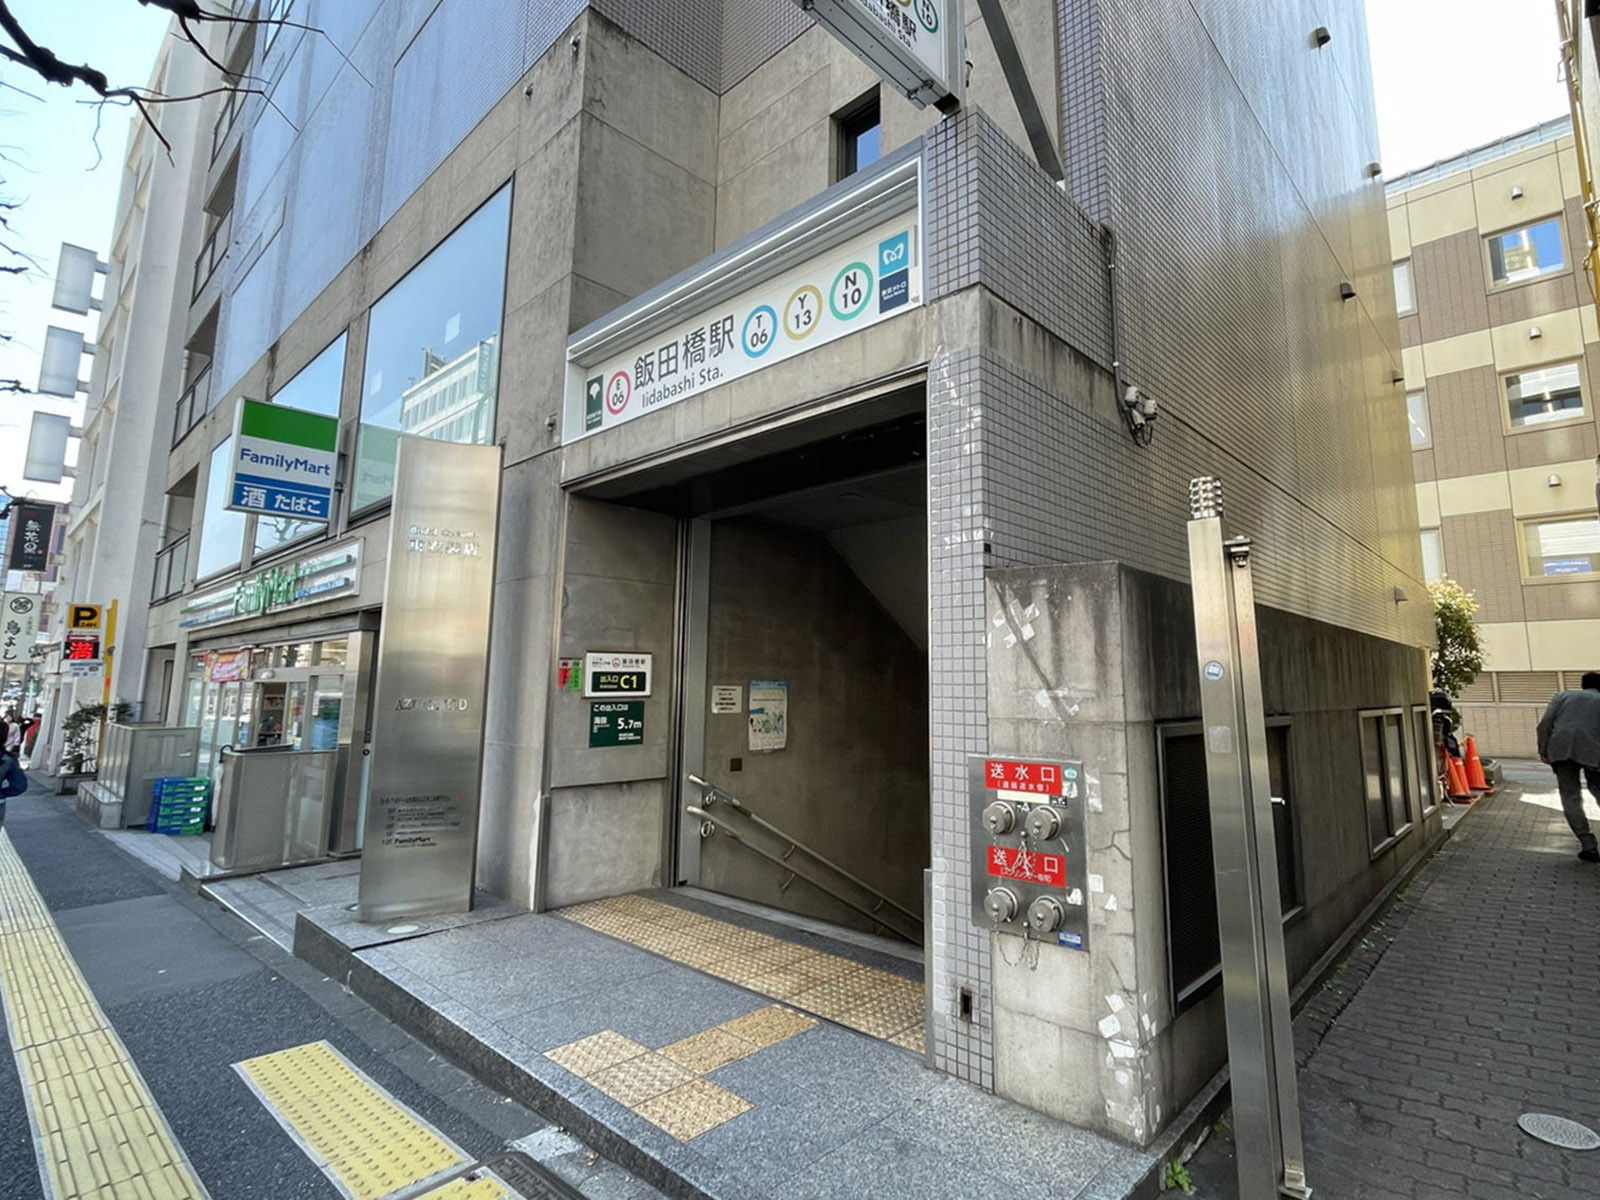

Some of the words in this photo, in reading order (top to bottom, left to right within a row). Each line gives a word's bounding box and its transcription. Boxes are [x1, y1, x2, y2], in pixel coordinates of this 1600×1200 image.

[921, 8, 933, 26] 10
[845, 271, 857, 290] N
[798, 294, 807, 309] Y
[842, 288, 862, 309] 10
[755, 314, 763, 328] T
[794, 310, 812, 329] 13
[750, 328, 769, 348] 06
[634, 313, 735, 392] 飯田橋駅
[616, 379, 621, 390] E
[642, 371, 695, 408] Iidabashi
[699, 366, 724, 386] Sta.
[612, 391, 625, 406] 06
[240, 447, 331, 476] FamilyMart
[241, 486, 267, 508] 酒
[274, 494, 321, 515] たばこ
[73, 607, 98, 627] P
[620, 675, 638, 689] C1
[617, 716, 642, 730] 5.7m
[991, 762, 1055, 784] 送水口
